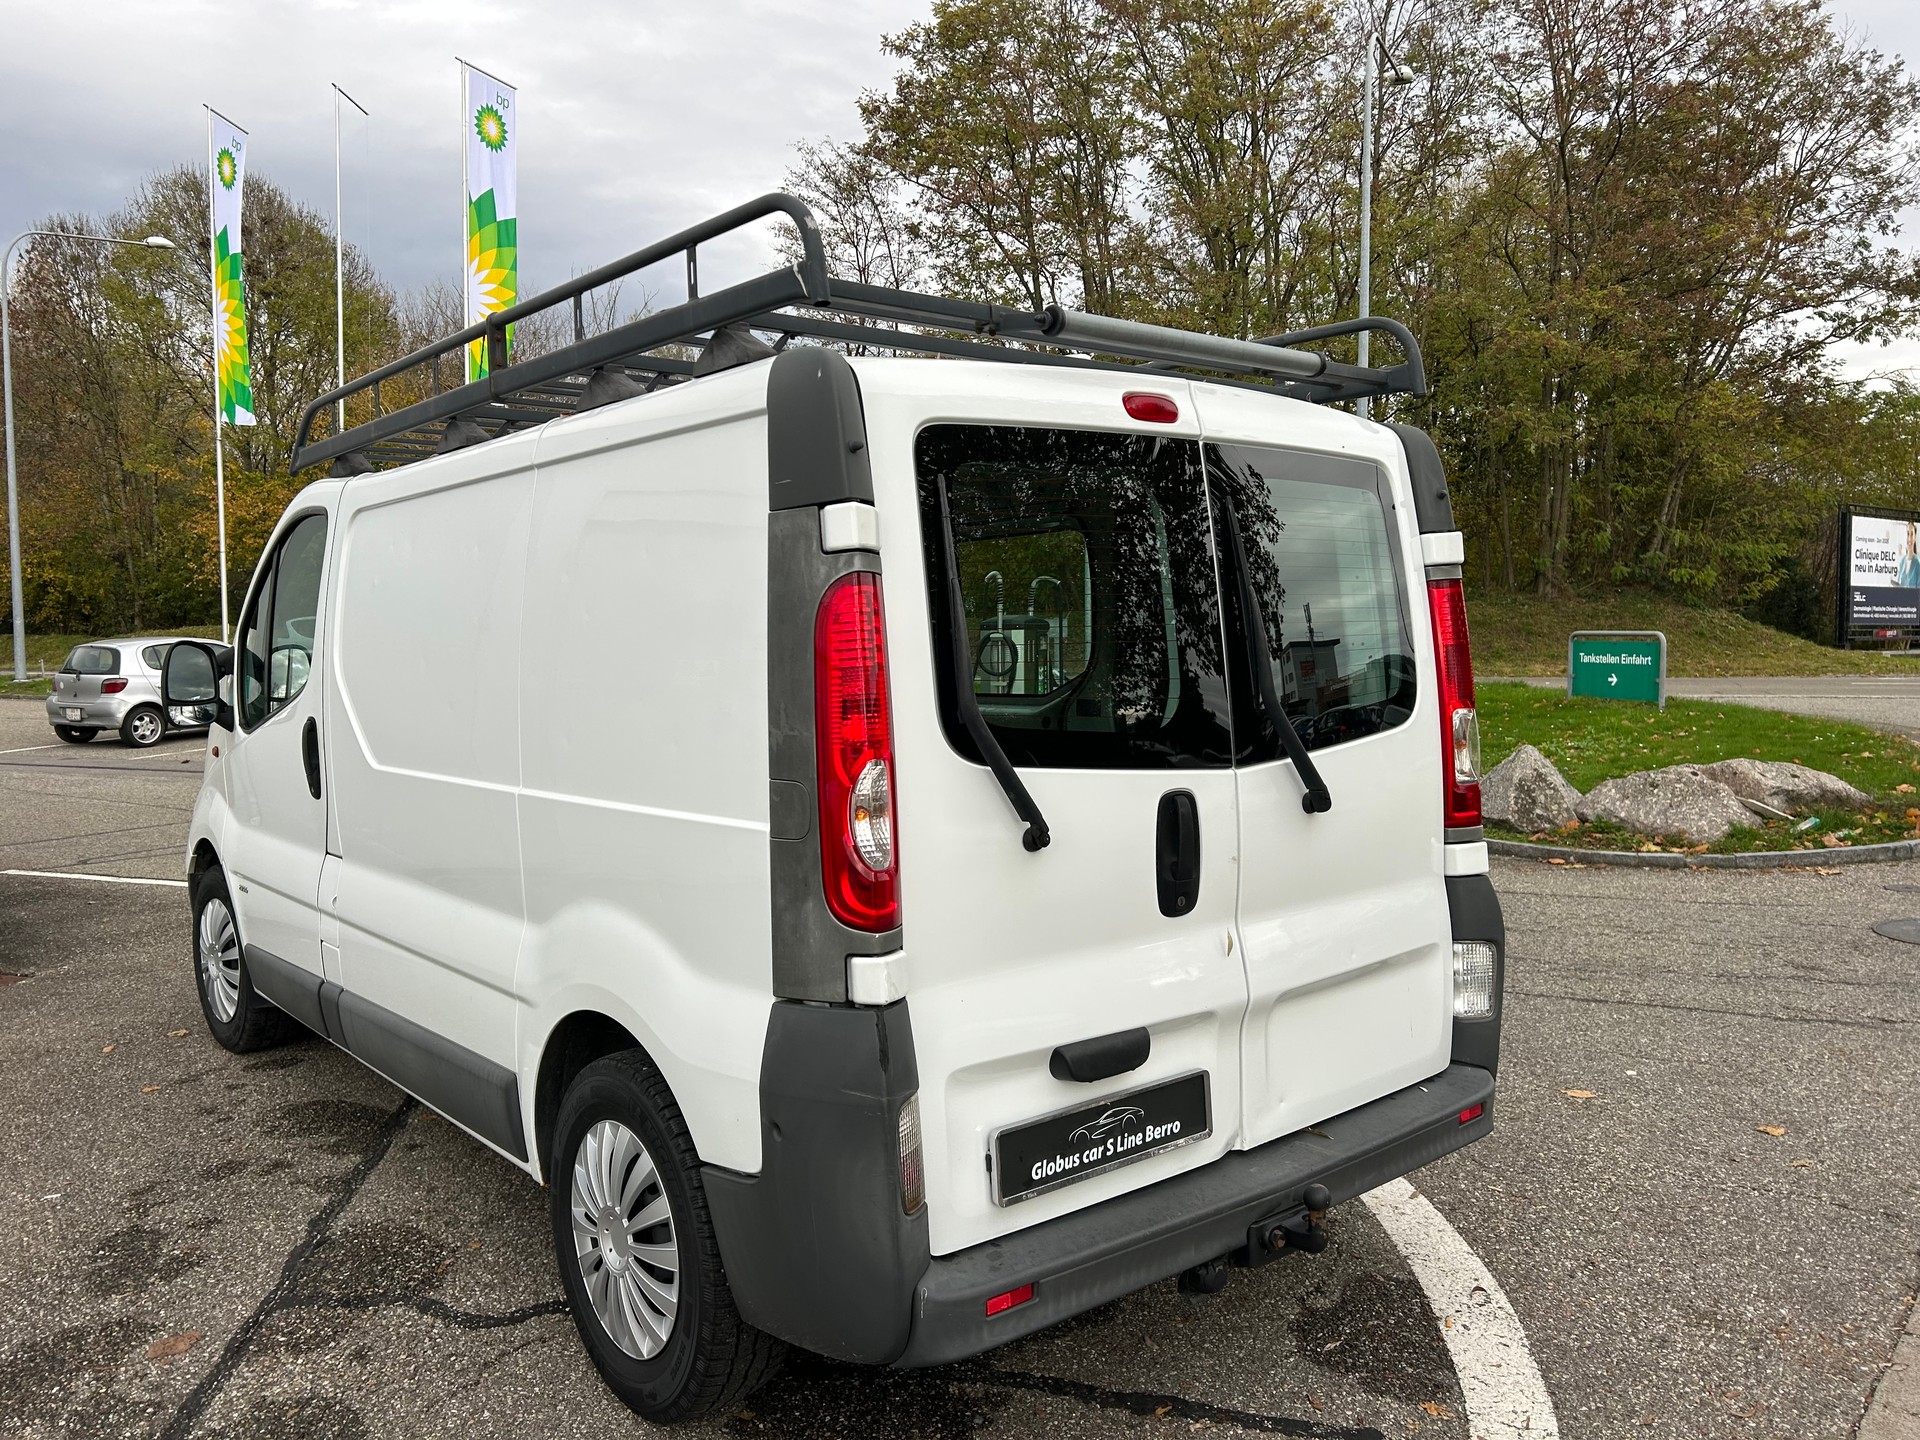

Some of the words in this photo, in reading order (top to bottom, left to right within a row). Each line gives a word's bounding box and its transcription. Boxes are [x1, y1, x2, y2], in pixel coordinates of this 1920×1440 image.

[496, 90, 510, 111] bp
[231, 135, 242, 153] bp
[1855, 548, 1879, 562] Clinique
[1880, 551, 1896, 562] DELC
[1855, 564, 1866, 572] neu
[1867, 562, 1873, 573] in
[1874, 563, 1898, 577] Aarburg
[1579, 652, 1620, 664] Tankstellen
[1621, 653, 1652, 665] Einfahrt
[1031, 1154, 1080, 1180] Globus
[1082, 1144, 1104, 1164] car
[1106, 1137, 1115, 1156] S
[1116, 1132, 1143, 1152] Line
[1145, 1120, 1181, 1143] Berro
